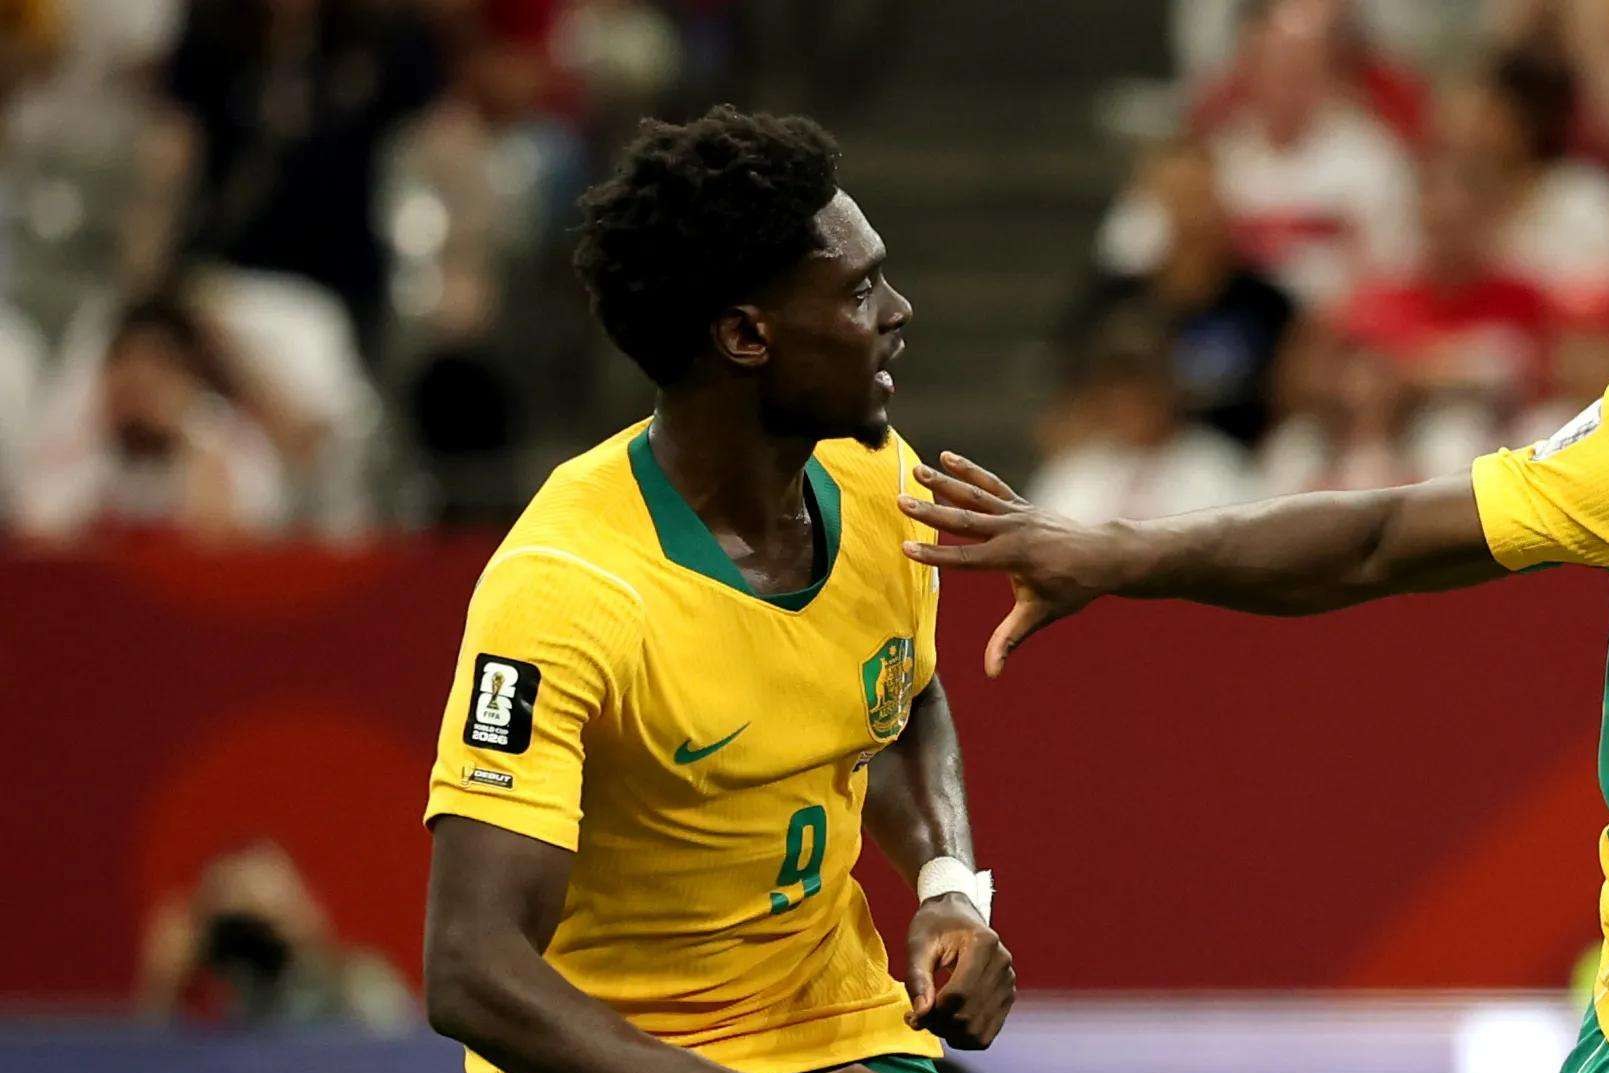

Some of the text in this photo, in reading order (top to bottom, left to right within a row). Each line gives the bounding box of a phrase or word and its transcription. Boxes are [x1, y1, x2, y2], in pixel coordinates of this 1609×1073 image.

[482, 710, 501, 721] FIFA
[472, 730, 509, 746] 2026
[474, 769, 511, 782] DEBUT
[770, 804, 827, 914] 9
